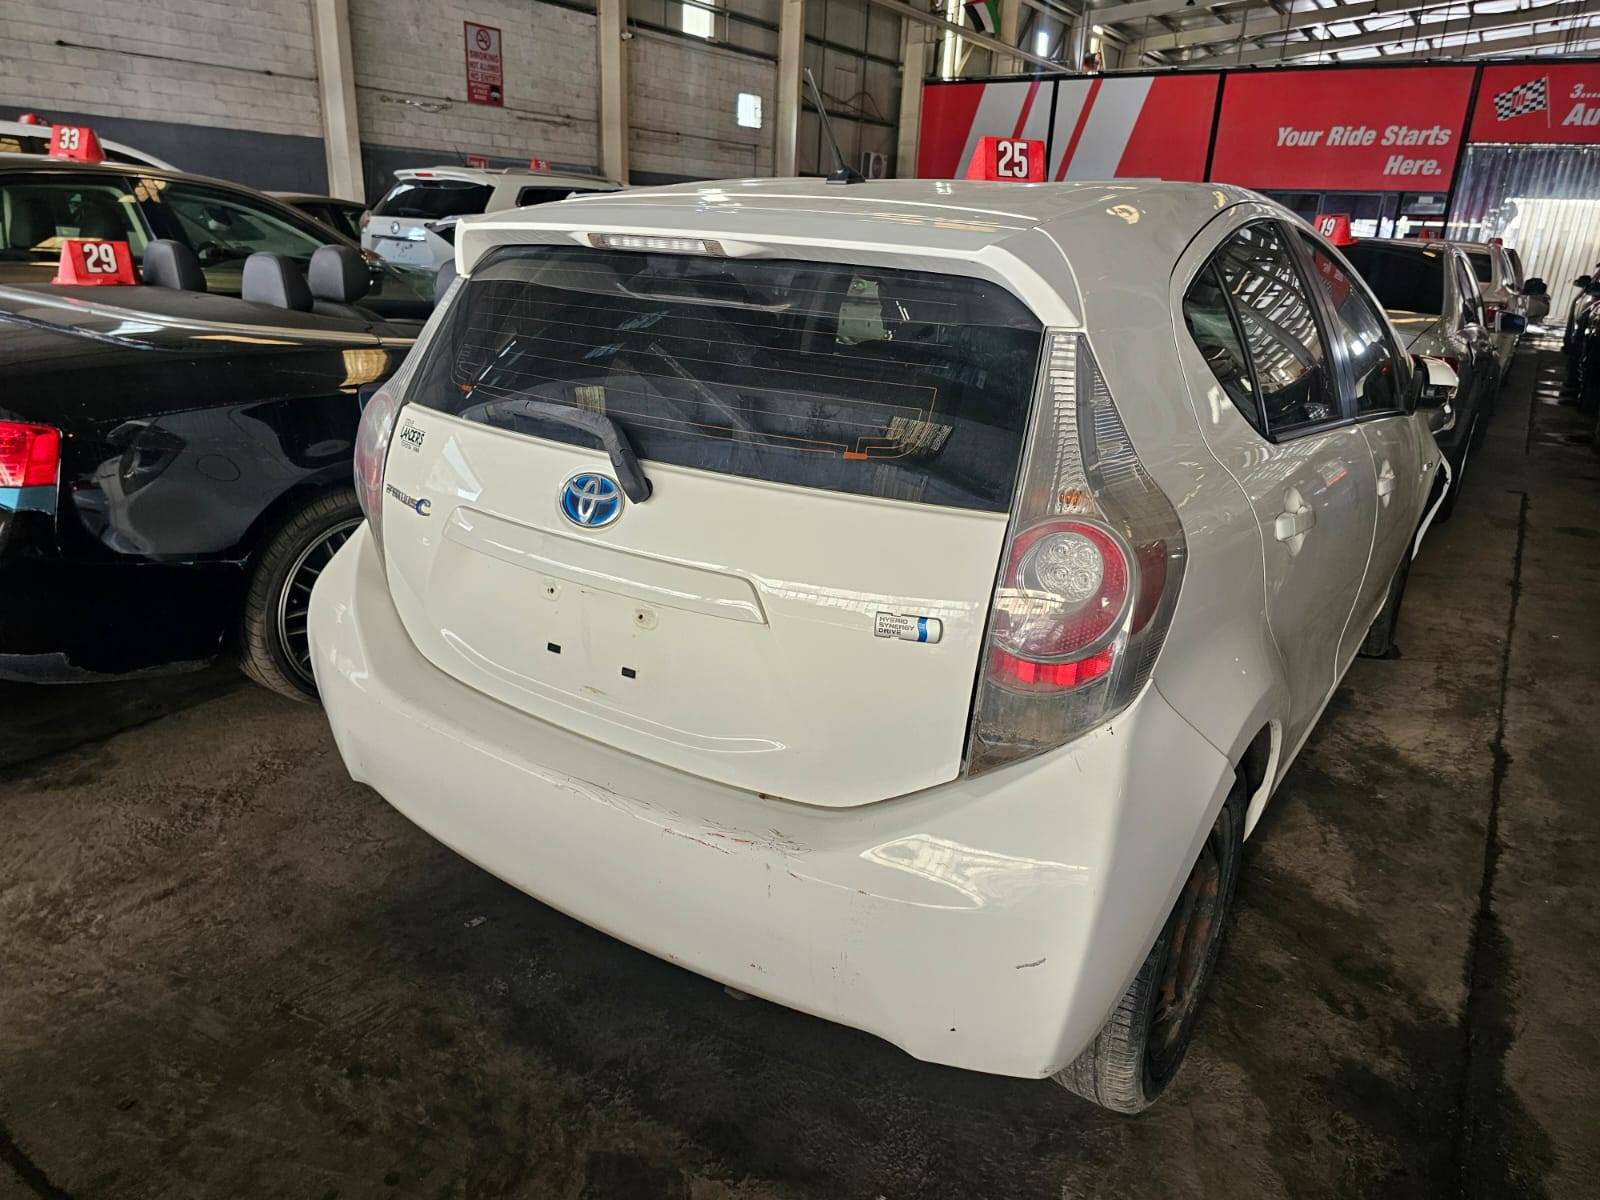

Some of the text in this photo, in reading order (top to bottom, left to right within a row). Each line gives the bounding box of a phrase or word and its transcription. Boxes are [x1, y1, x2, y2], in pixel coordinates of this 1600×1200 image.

[59, 127, 80, 150] 33
[1276, 125, 1452, 147] Your Ride Starts
[998, 141, 1028, 178] 25
[1383, 155, 1442, 176] Here.
[1320, 217, 1336, 237] 19
[83, 243, 117, 273] 29
[879, 616, 908, 625] HYBRID
[879, 622, 915, 631] SYNERGY
[878, 627, 902, 636] DRIVE
